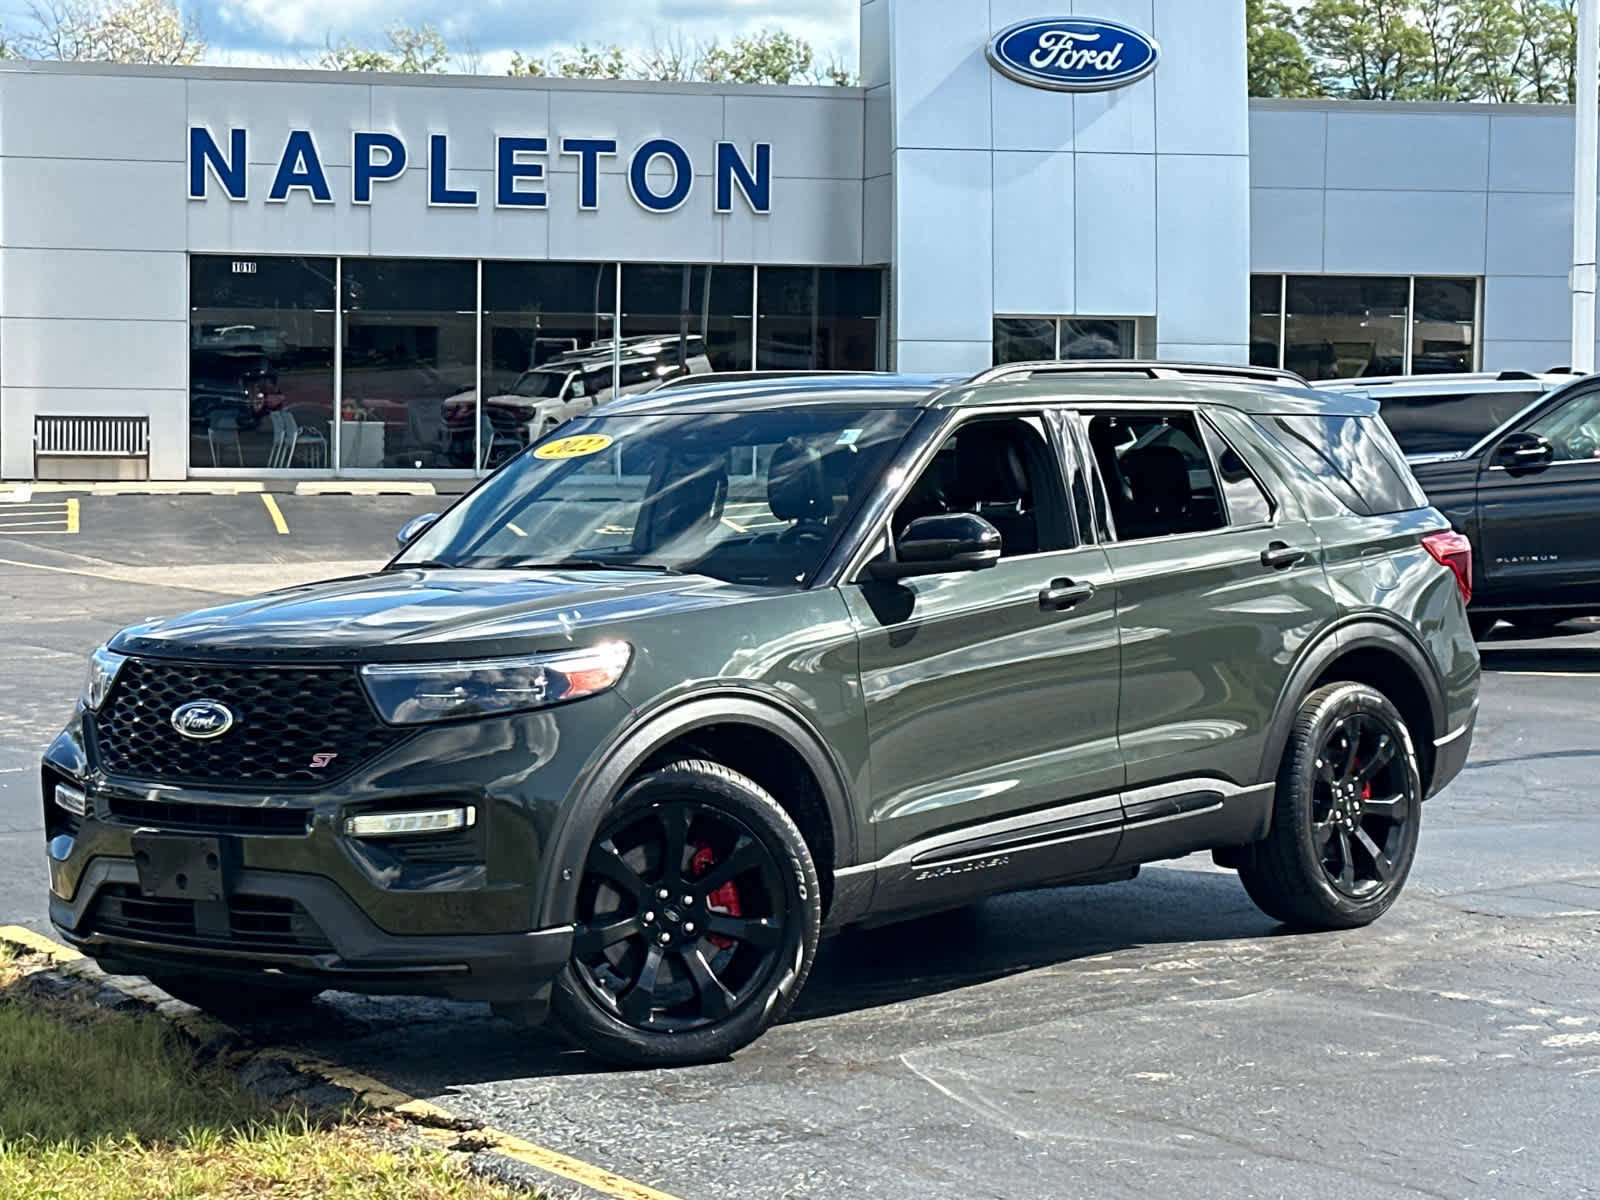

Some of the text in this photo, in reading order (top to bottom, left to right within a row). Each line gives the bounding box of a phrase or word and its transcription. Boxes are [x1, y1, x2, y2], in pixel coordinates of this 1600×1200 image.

[1029, 30, 1124, 71] Ford
[186, 126, 773, 214] NAPLETON
[232, 261, 257, 274] 1010
[1496, 554, 1559, 564] PLATINUM
[181, 707, 220, 729] Ford
[308, 752, 338, 768] ST
[915, 856, 1010, 881] EXPLORER
